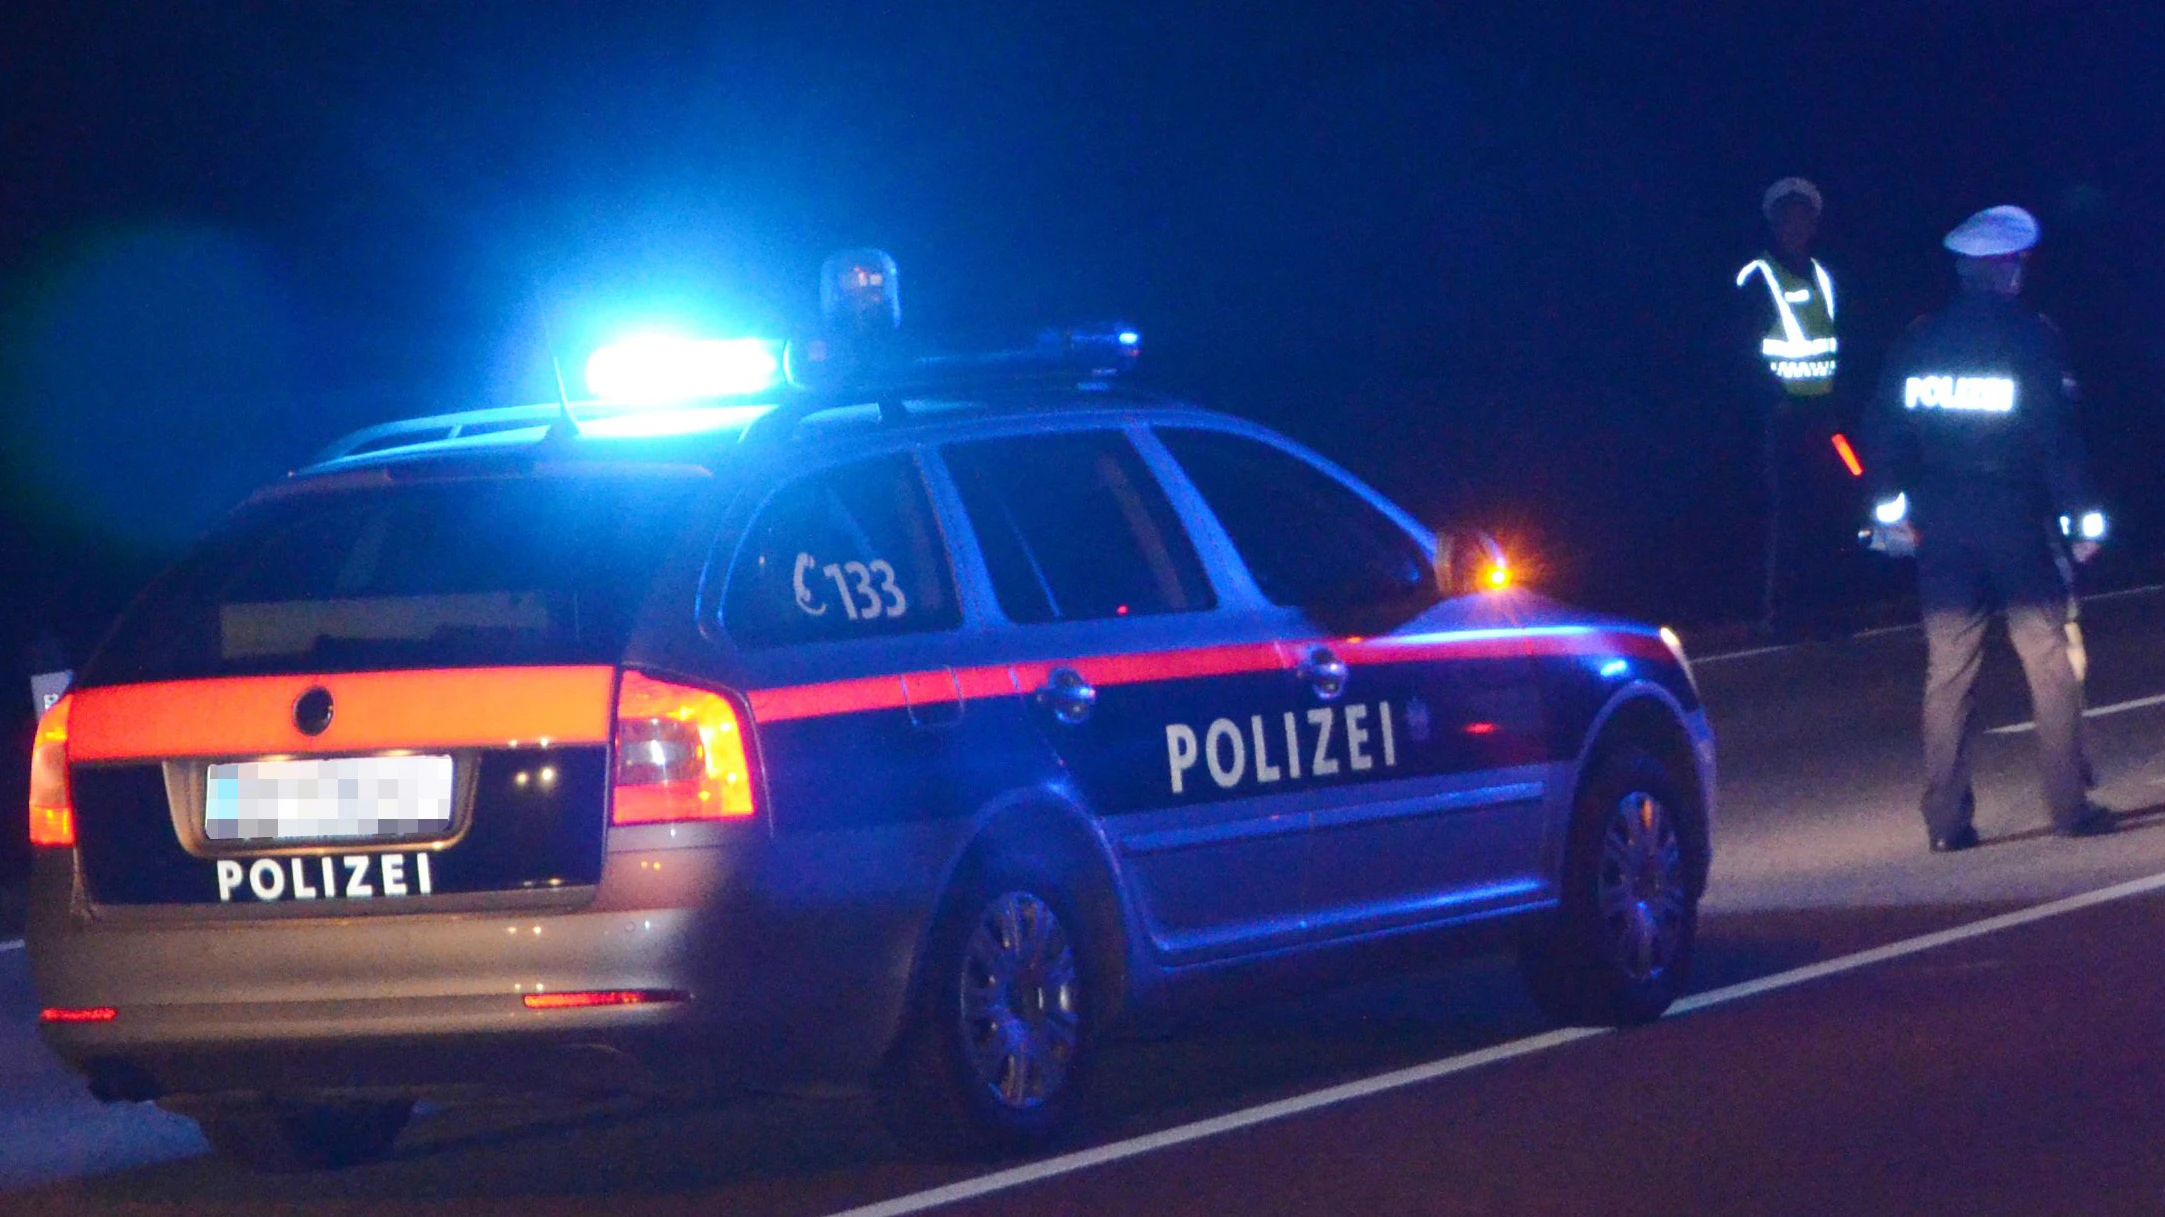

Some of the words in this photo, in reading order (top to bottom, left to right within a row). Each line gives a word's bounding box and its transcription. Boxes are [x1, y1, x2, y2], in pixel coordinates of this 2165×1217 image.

[823, 559, 906, 620] 133
[1166, 701, 1396, 793] POLIZEI
[217, 852, 431, 901] POLIZEI
